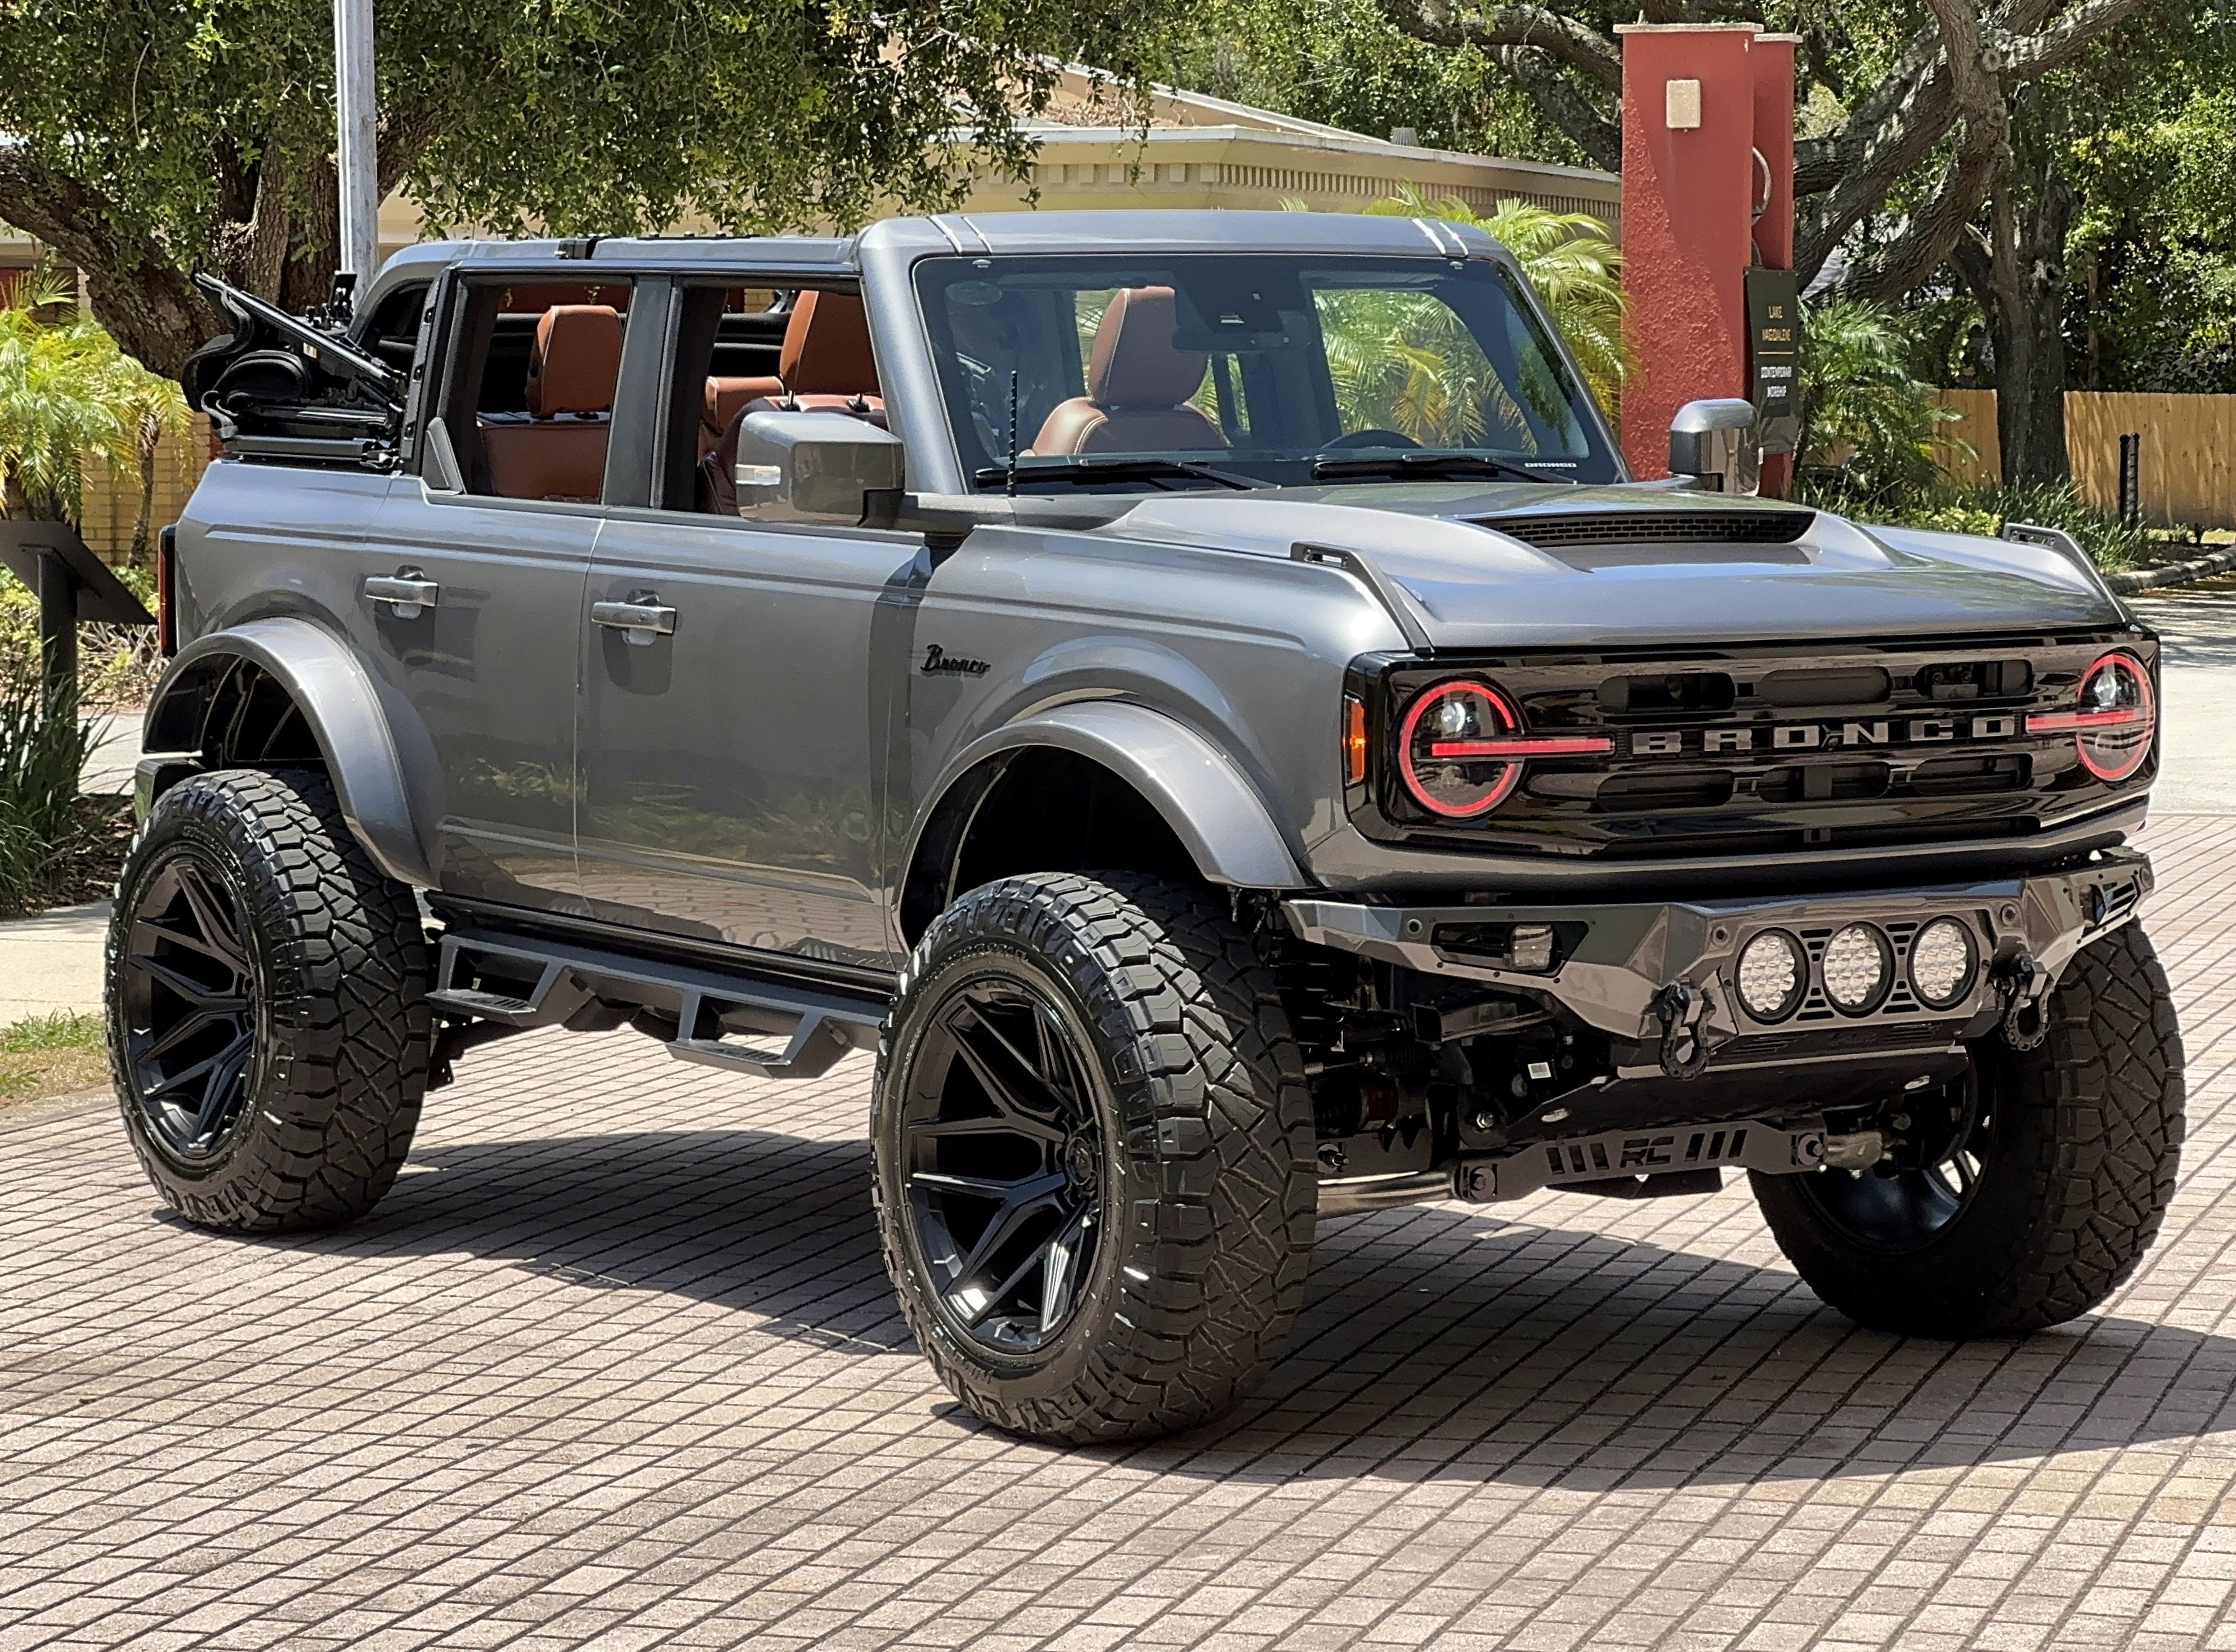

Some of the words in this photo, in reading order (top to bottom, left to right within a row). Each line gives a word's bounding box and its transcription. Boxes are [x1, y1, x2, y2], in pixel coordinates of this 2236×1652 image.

[920, 644, 991, 674] Bronco
[1632, 716, 2015, 754] BRONCO
[1620, 1136, 1675, 1168] RC
